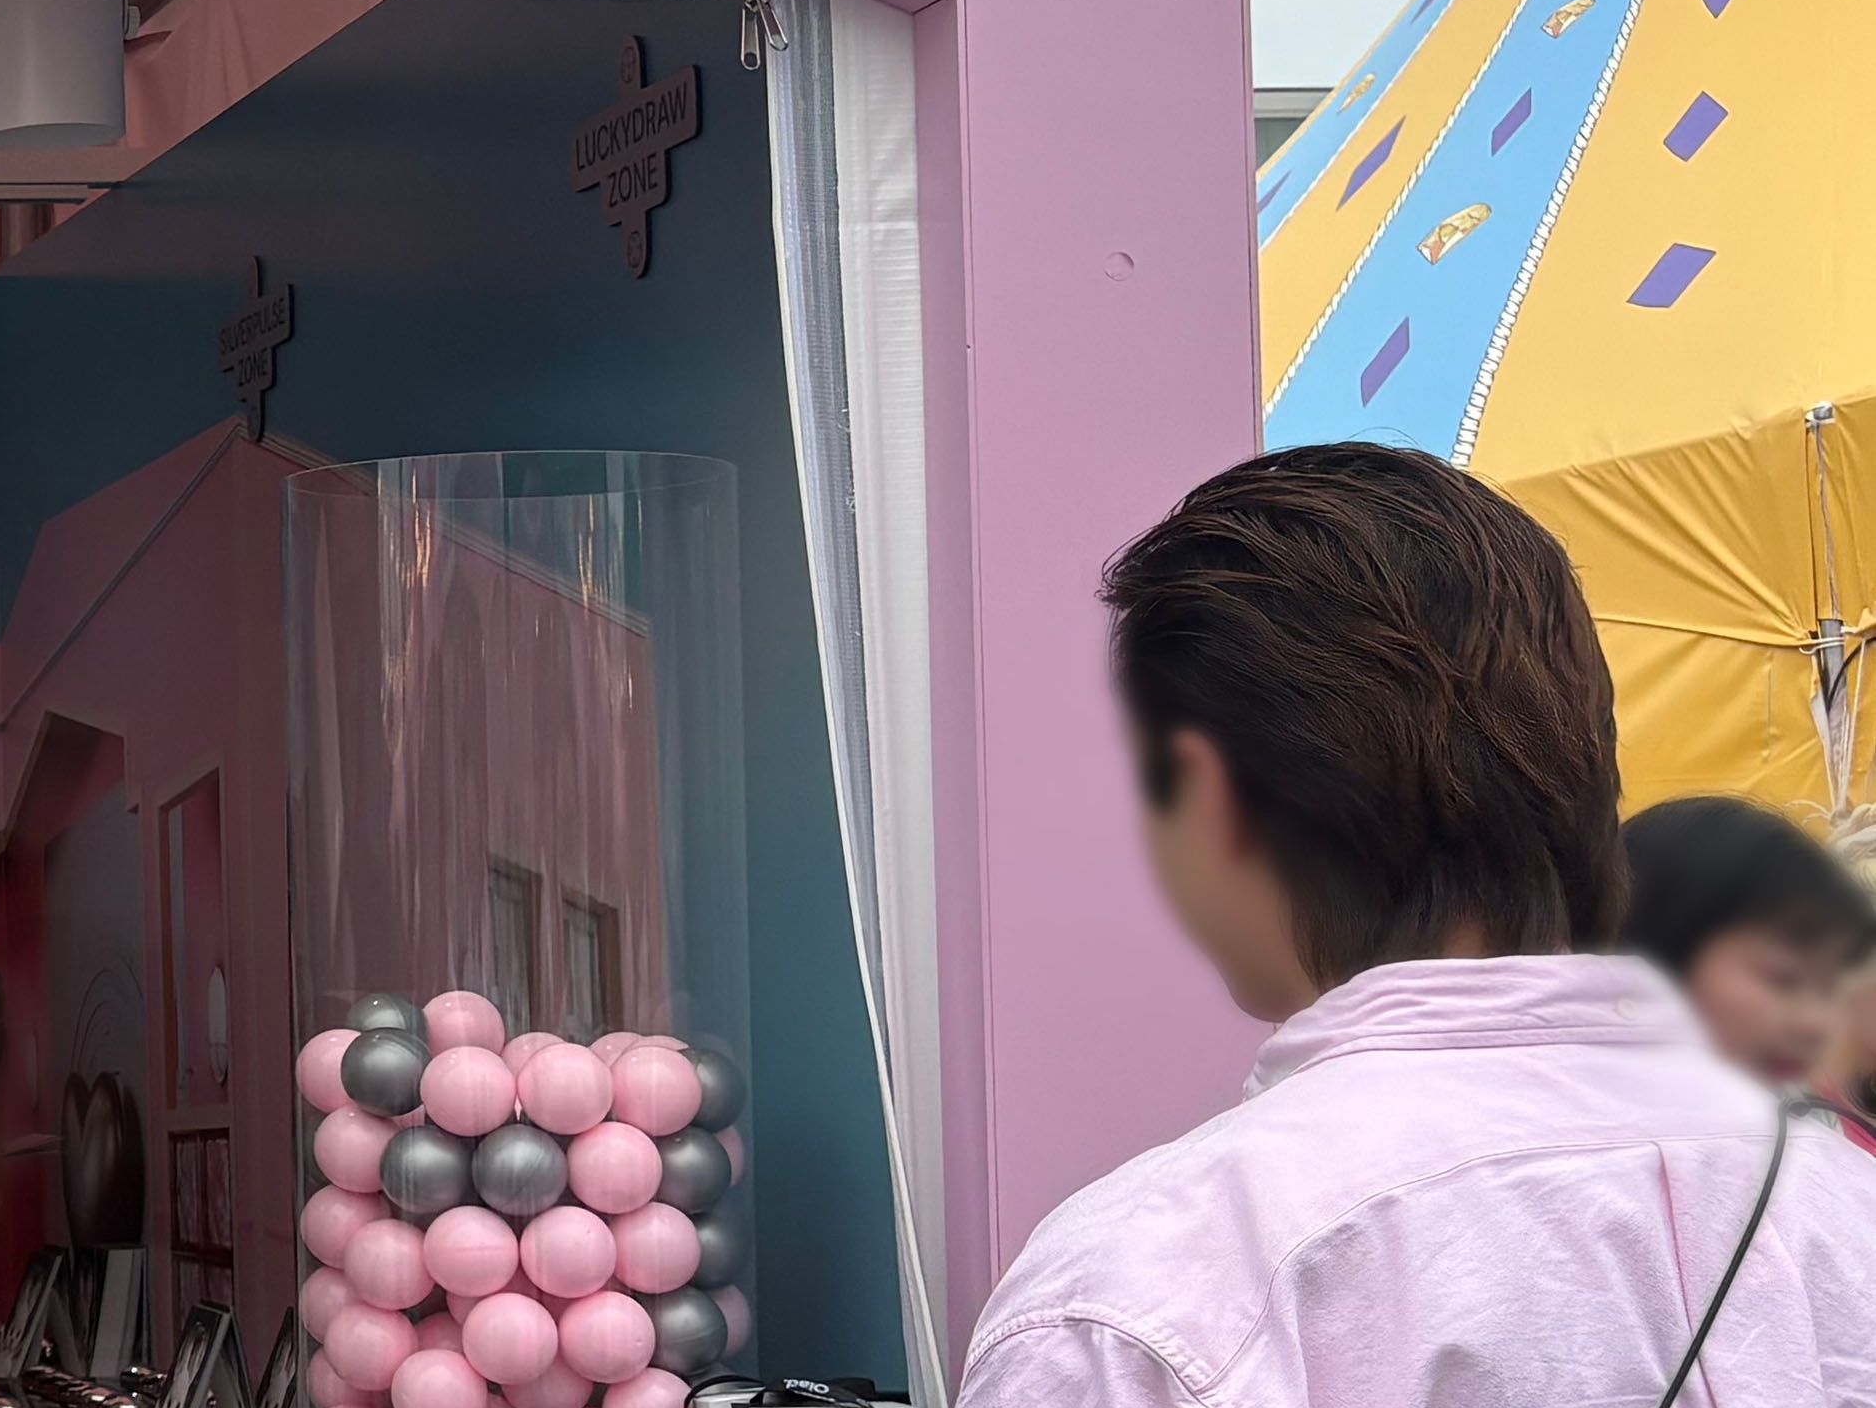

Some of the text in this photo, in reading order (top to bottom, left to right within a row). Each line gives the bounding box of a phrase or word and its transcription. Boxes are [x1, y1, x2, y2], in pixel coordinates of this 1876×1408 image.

[575, 85, 688, 173] LUCKYDRAW
[606, 152, 658, 210] ZONE
[239, 349, 268, 386] ZONE
